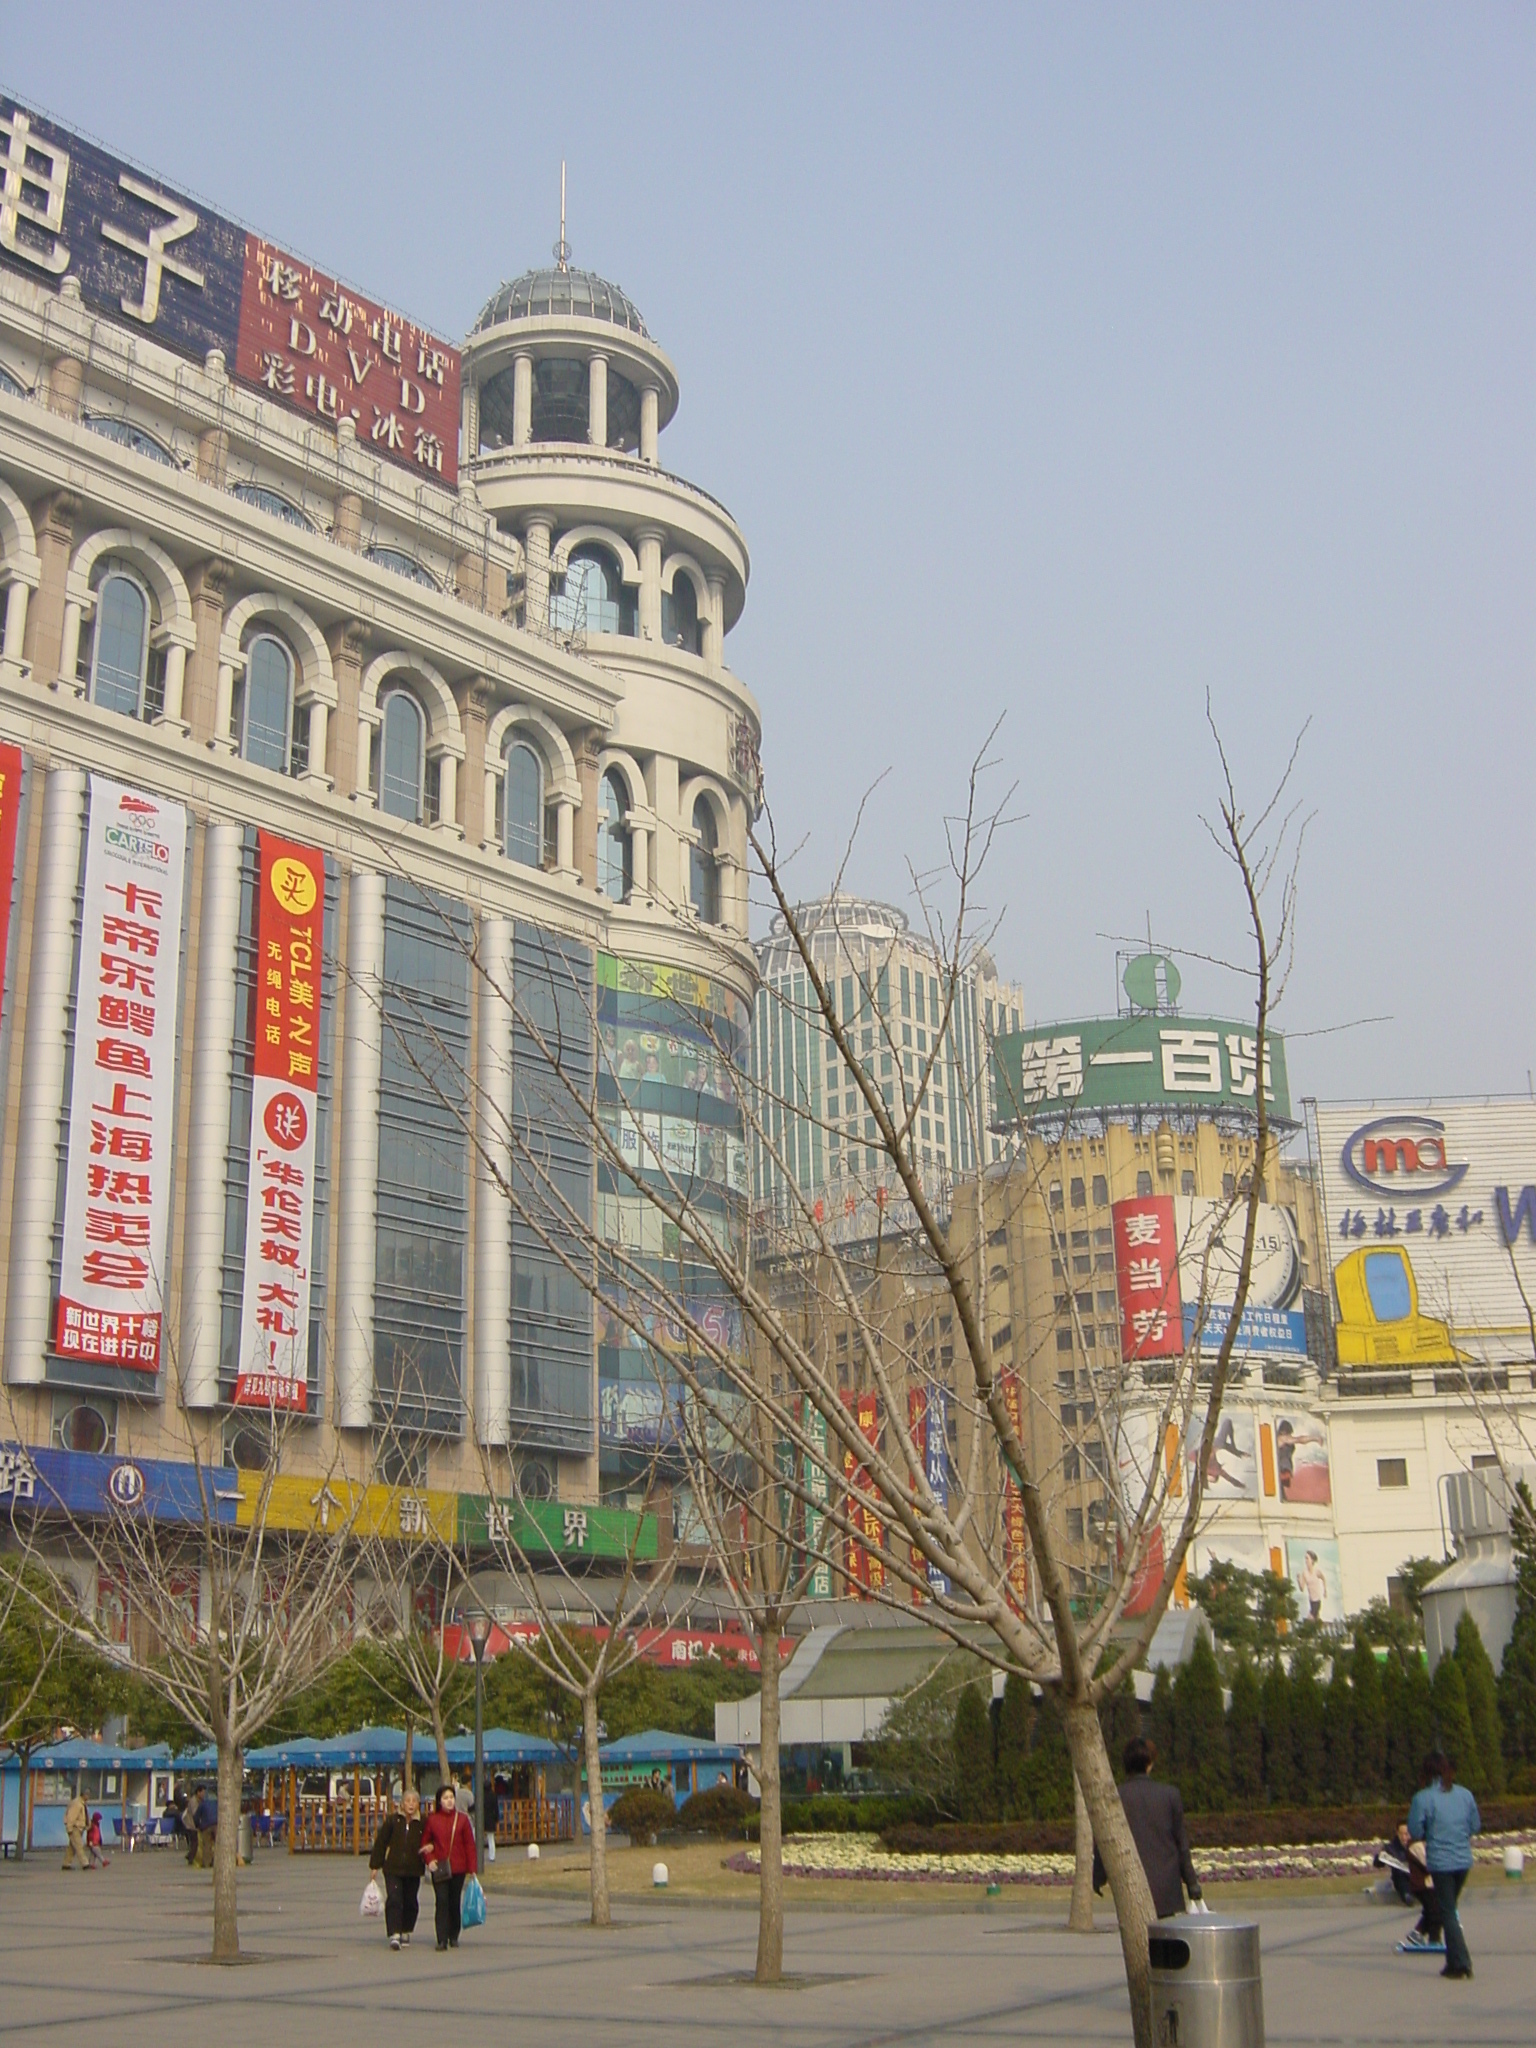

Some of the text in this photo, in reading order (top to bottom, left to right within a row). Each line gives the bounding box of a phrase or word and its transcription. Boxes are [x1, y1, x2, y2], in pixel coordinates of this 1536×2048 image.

[0, 110, 205, 324] 电子
[267, 257, 446, 386] 移动电话
[288, 316, 426, 415] DVD
[280, 866, 308, 907] 买
[265, 940, 283, 1046] 无绳电话
[288, 926, 314, 1077] TCL美之声
[82, 882, 163, 1290] 卡帝乐鳄鱼上海热卖会
[1021, 1029, 1276, 1104] 第一百货
[1125, 1213, 1168, 1343] 麦当劳
[62, 1328, 157, 1361] 现在进行中
